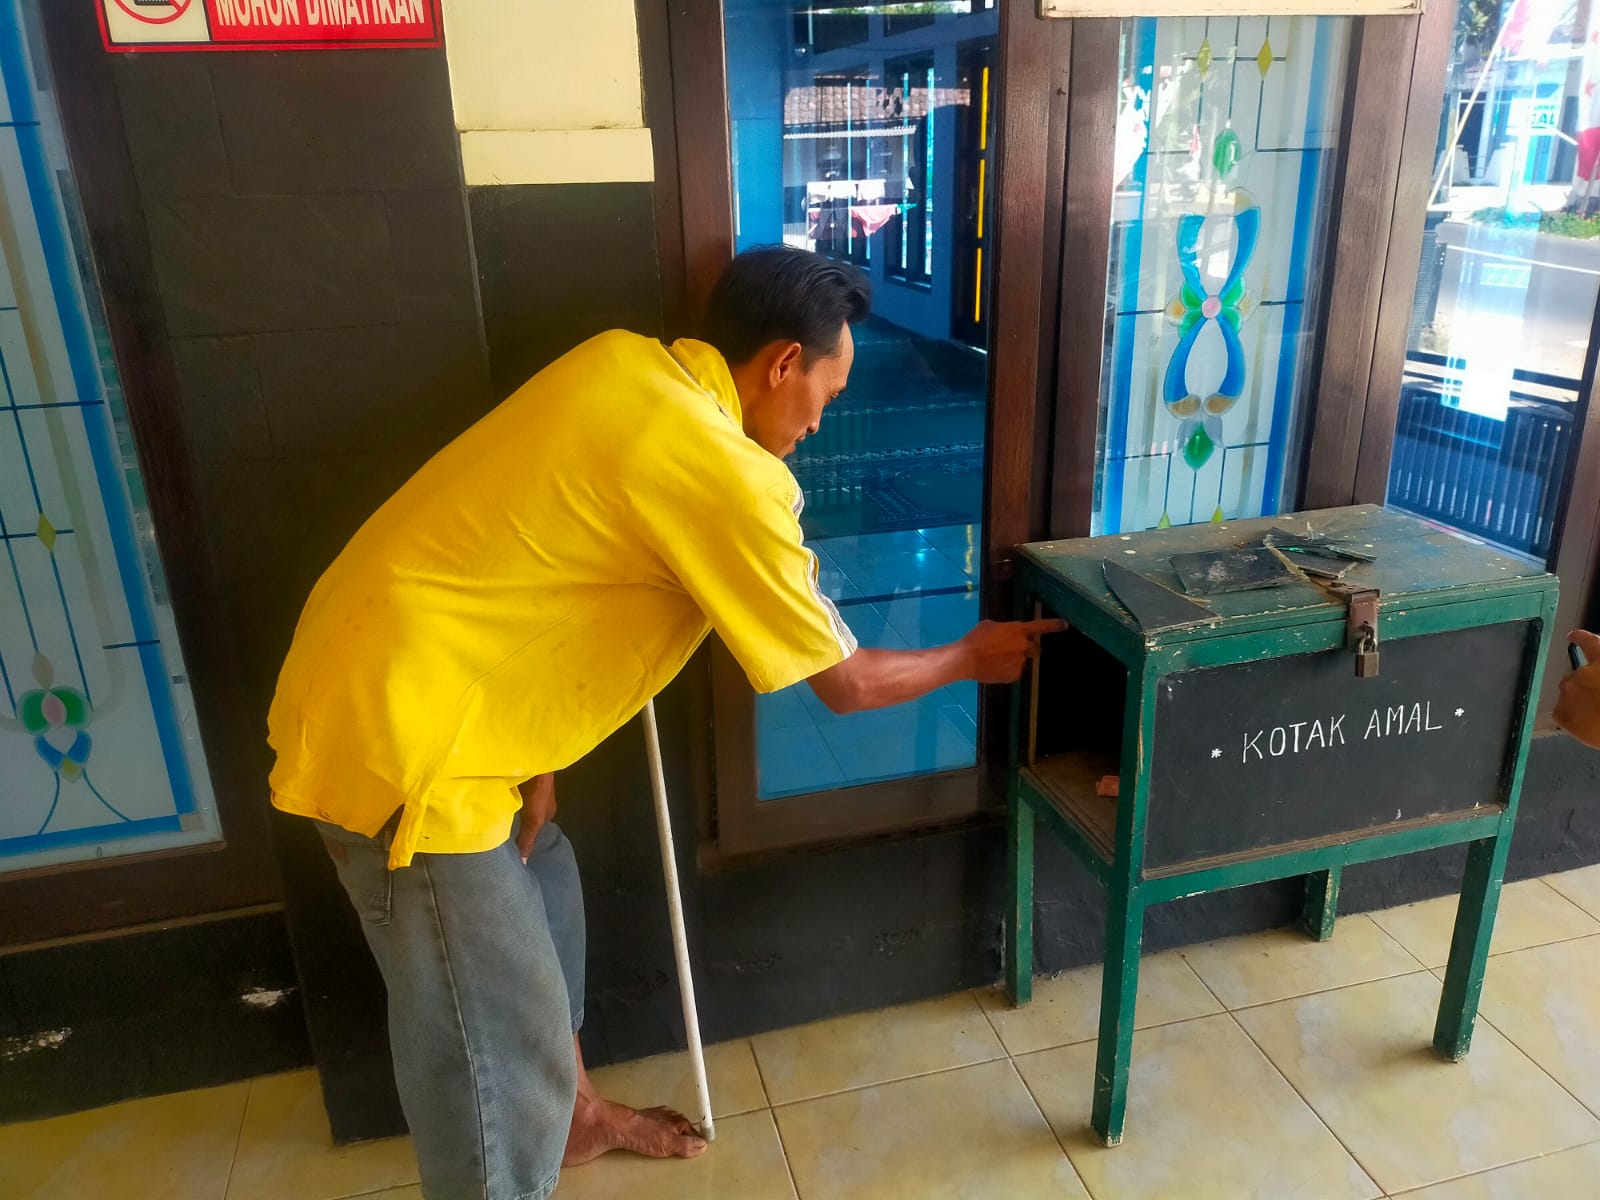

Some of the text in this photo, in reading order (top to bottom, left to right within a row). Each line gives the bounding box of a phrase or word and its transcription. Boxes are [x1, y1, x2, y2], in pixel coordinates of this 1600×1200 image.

[216, 0, 425, 27] MOHON DIMATIKAN
[1242, 701, 1442, 763] KOTAK AMAL
